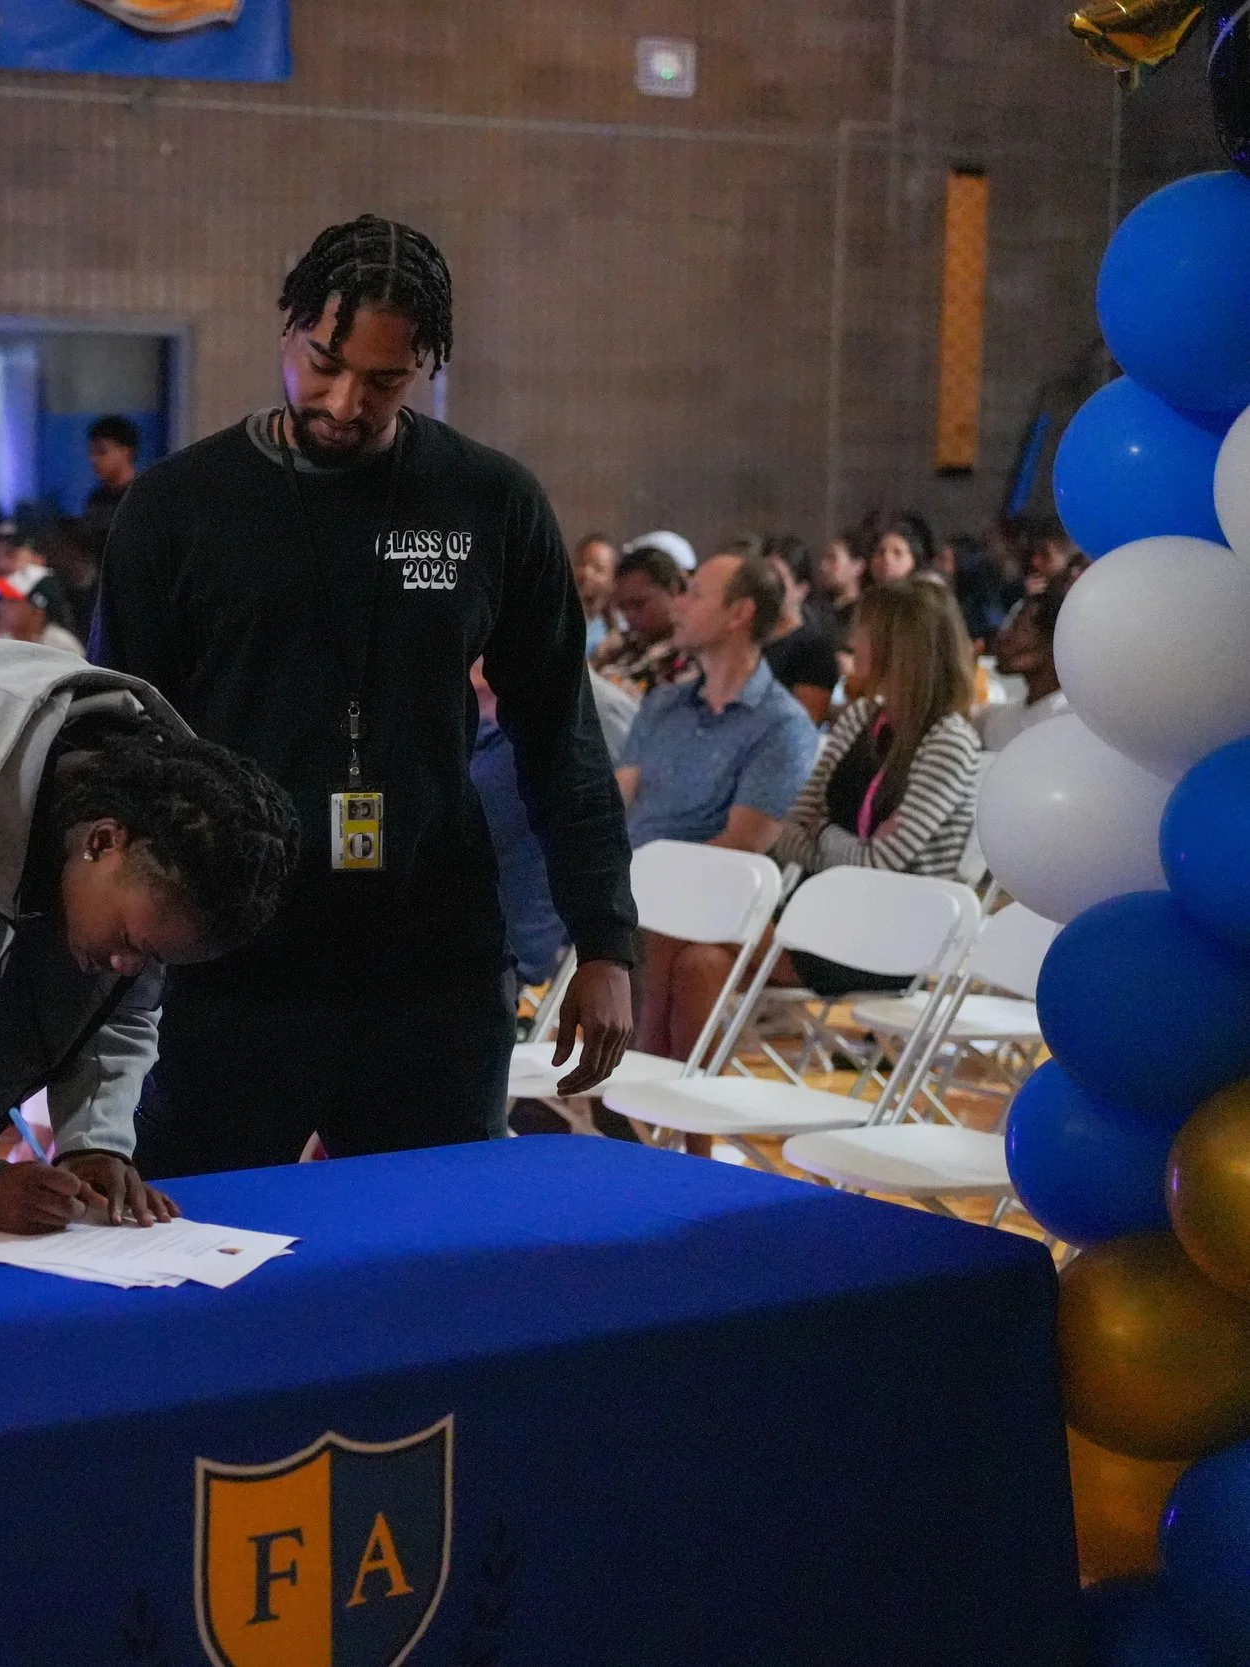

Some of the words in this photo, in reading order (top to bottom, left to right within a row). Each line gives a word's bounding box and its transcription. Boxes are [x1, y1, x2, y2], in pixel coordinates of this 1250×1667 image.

[446, 531, 472, 560] OF
[402, 559, 458, 590] 2026
[242, 1527, 305, 1627] F
[345, 1511, 414, 1608] A
